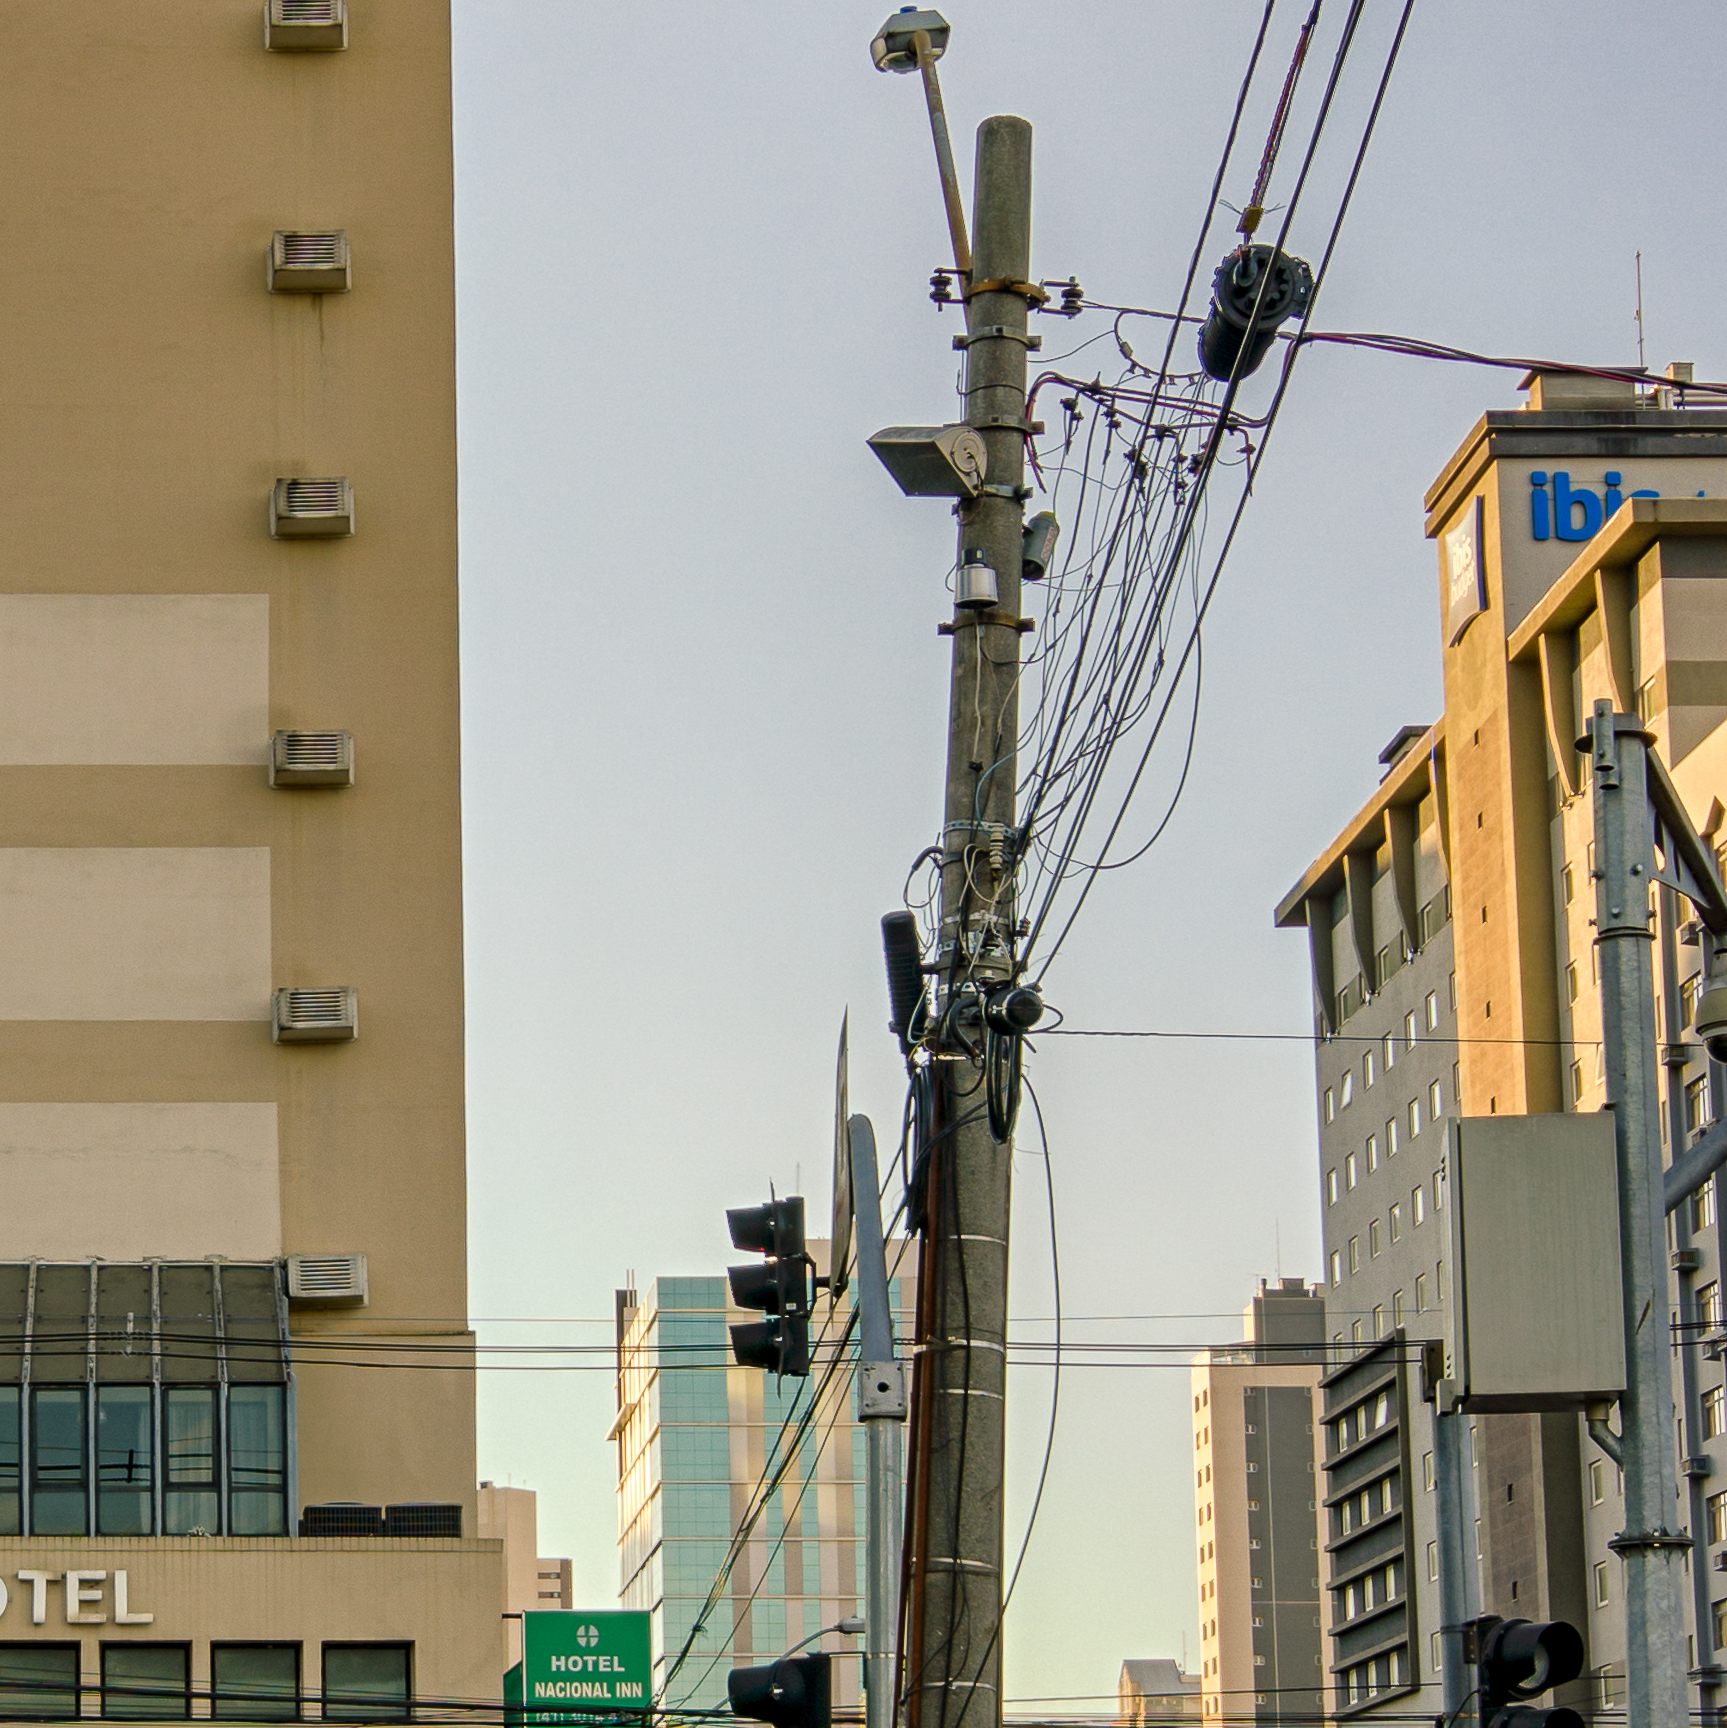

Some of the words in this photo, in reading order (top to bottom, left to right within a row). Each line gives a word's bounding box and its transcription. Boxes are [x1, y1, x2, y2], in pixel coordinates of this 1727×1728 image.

[1531, 471, 1660, 542] ibi
[551, 1655, 626, 1672] HOTEL
[535, 1681, 612, 1698] NACIONAL
[615, 1682, 642, 1698] INN
